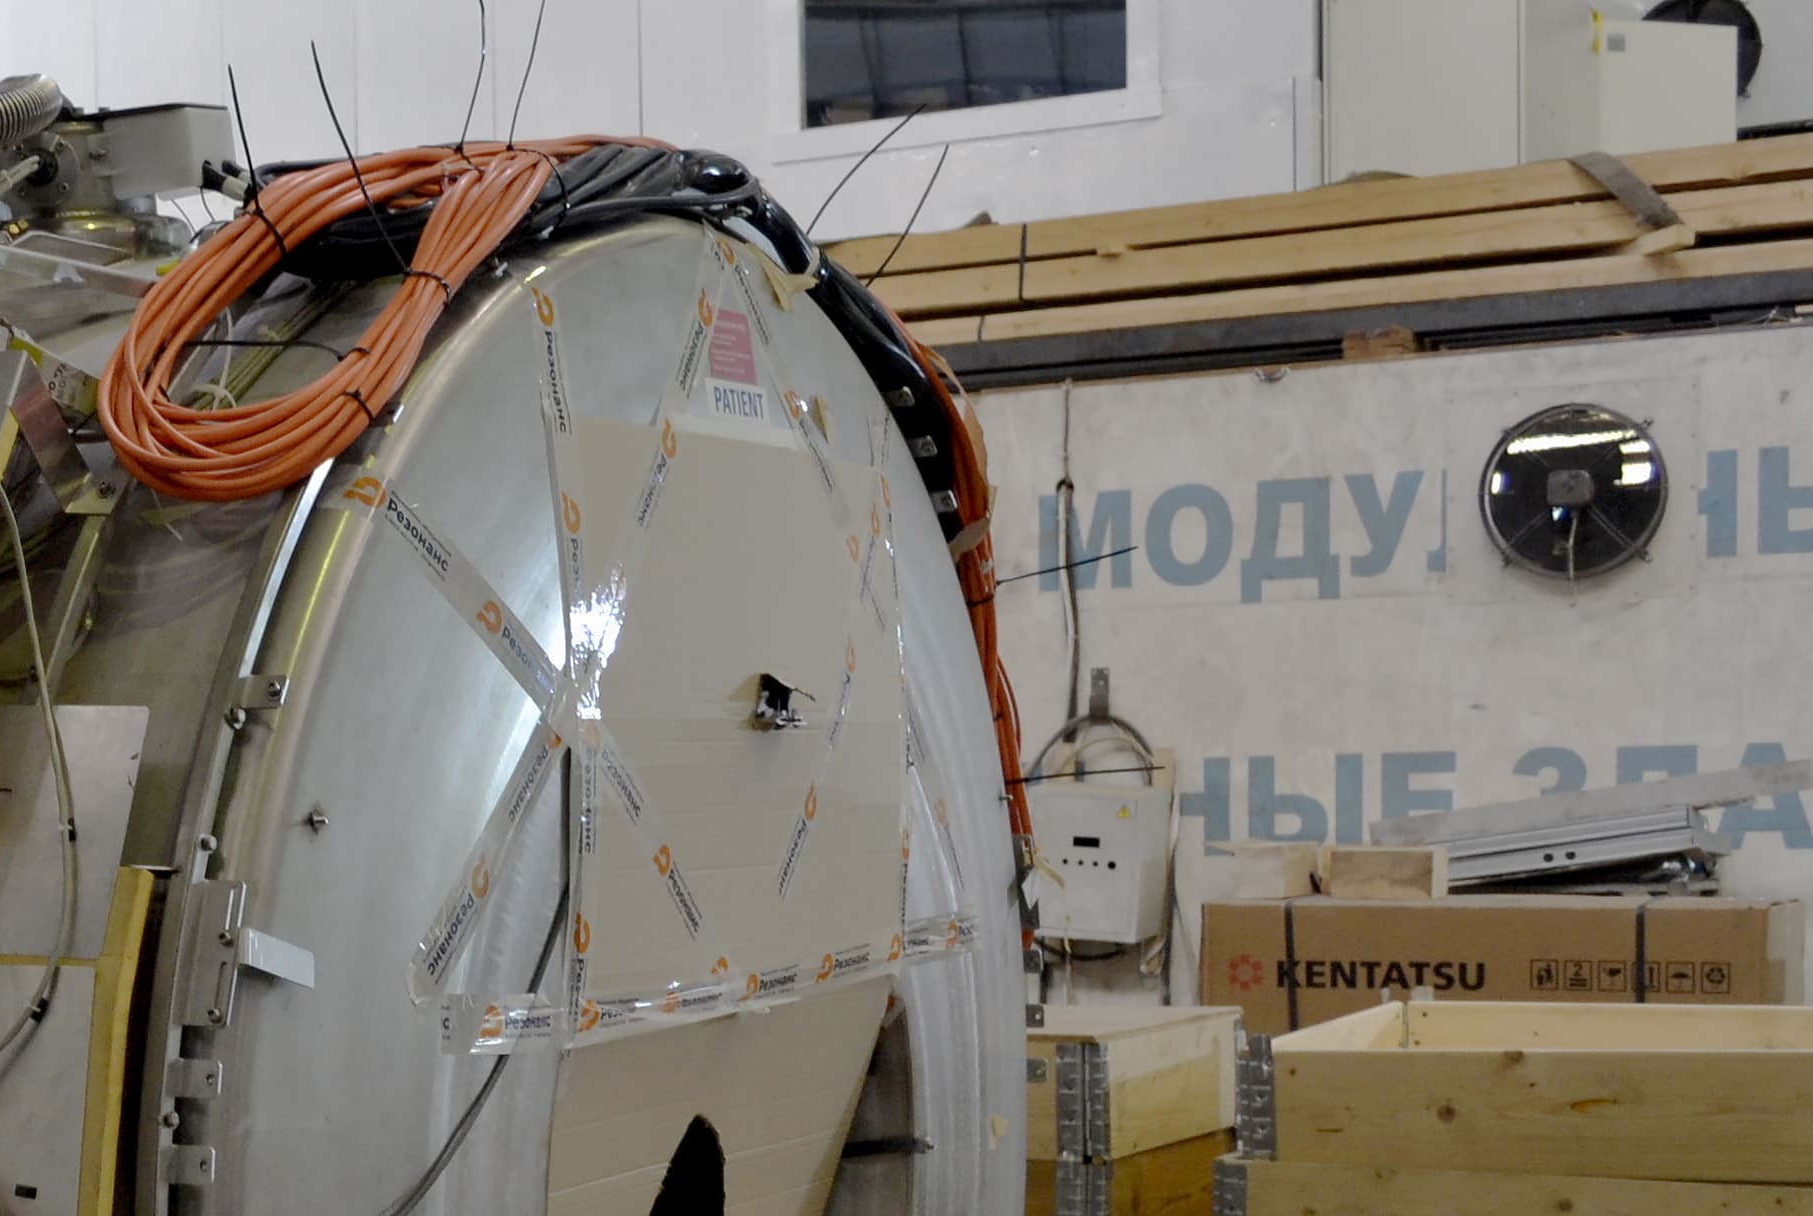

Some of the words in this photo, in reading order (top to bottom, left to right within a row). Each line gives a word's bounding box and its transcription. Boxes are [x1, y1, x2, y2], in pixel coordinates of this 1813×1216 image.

[714, 386, 764, 420] PATIENT
[387, 497, 449, 573] Резонанс
[509, 747, 549, 823] Резонанс
[427, 894, 476, 976] Резонанс
[1275, 959, 1486, 992] KENTATSU
